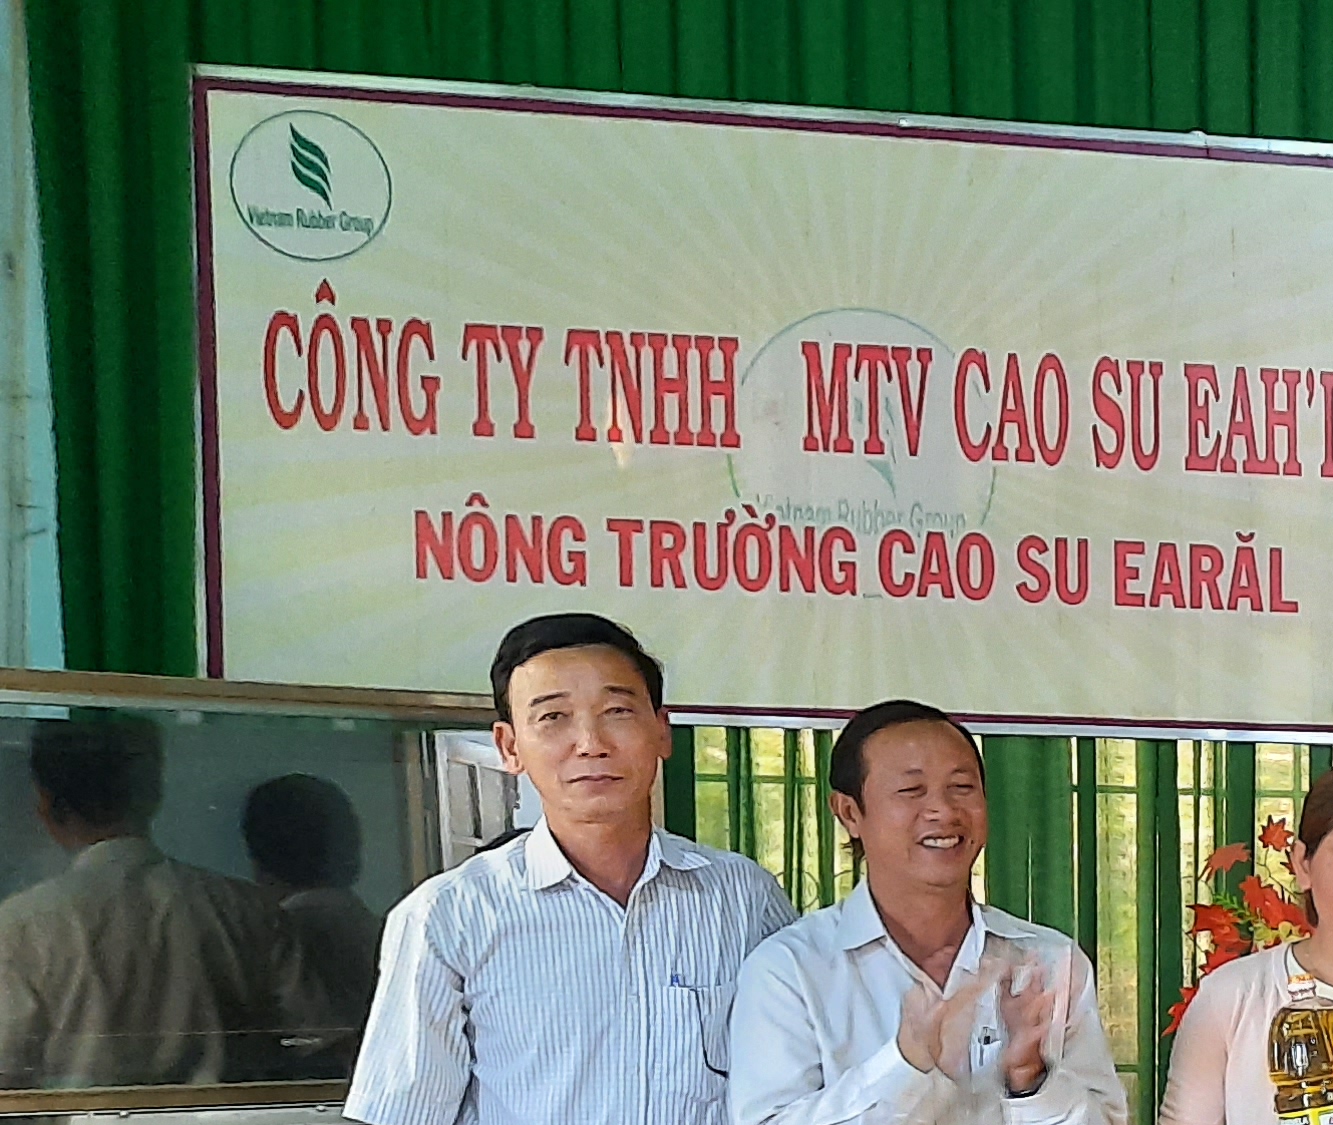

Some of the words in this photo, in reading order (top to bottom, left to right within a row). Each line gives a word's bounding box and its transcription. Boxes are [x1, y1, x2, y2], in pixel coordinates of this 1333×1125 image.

[263, 278, 441, 436] CÔNG
[461, 323, 544, 439] TY
[564, 329, 742, 448] TNHH
[801, 341, 933, 457] MTV
[954, 348, 1069, 466] CAO
[1092, 356, 1164, 472] SU
[414, 491, 588, 587] NÔNG
[606, 503, 858, 597] TRƯỜNG
[878, 528, 995, 601] CAO
[1016, 534, 1090, 605] SU
[1113, 531, 1299, 613] EARĂL
